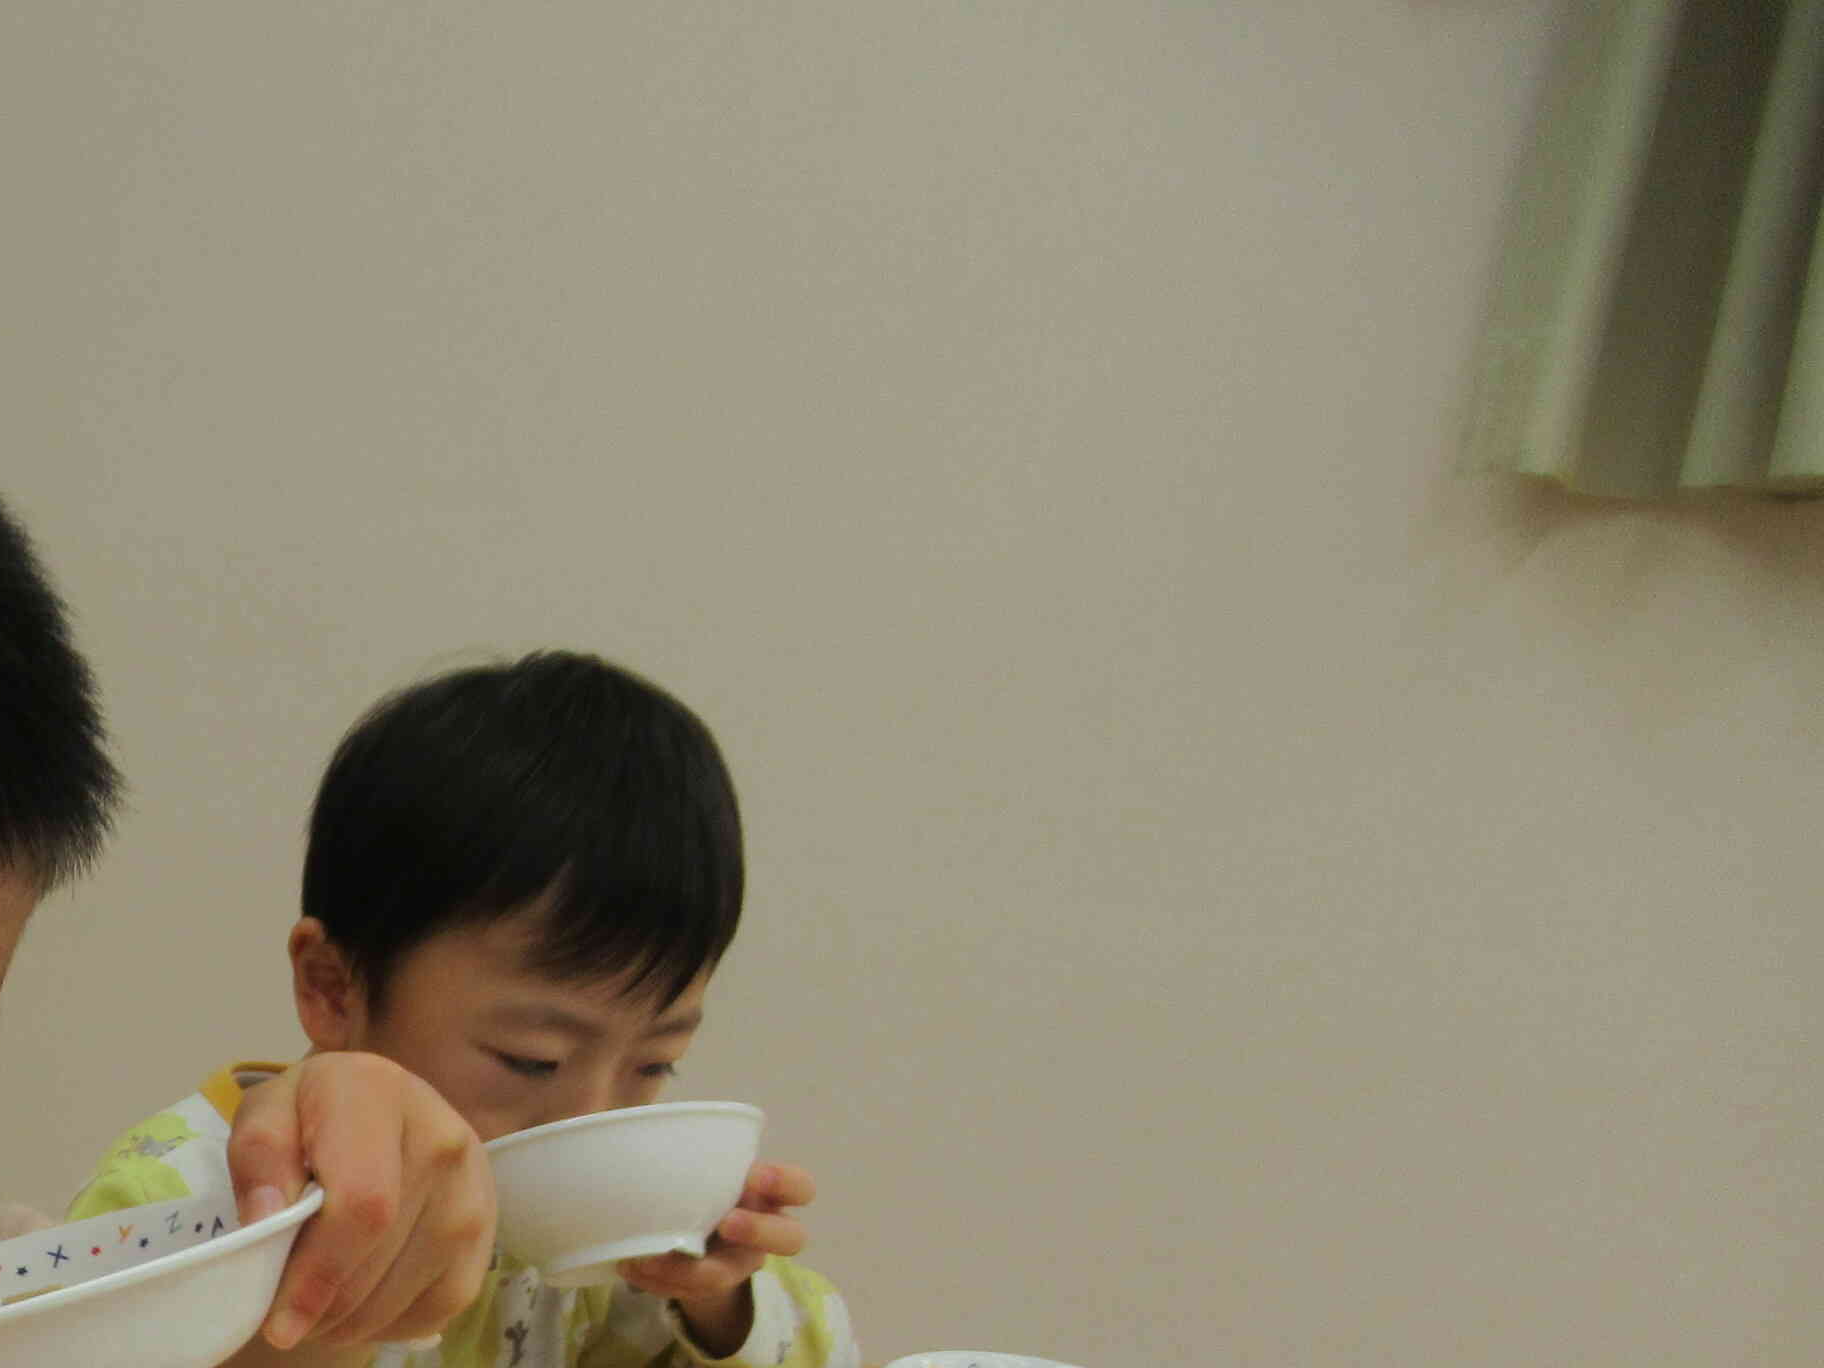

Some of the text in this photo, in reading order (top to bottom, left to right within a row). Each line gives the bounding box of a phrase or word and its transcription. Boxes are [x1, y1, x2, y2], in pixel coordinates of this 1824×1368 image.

[47, 1245, 69, 1268] X
[119, 1224, 133, 1242] Y
[165, 1211, 183, 1234] Z
